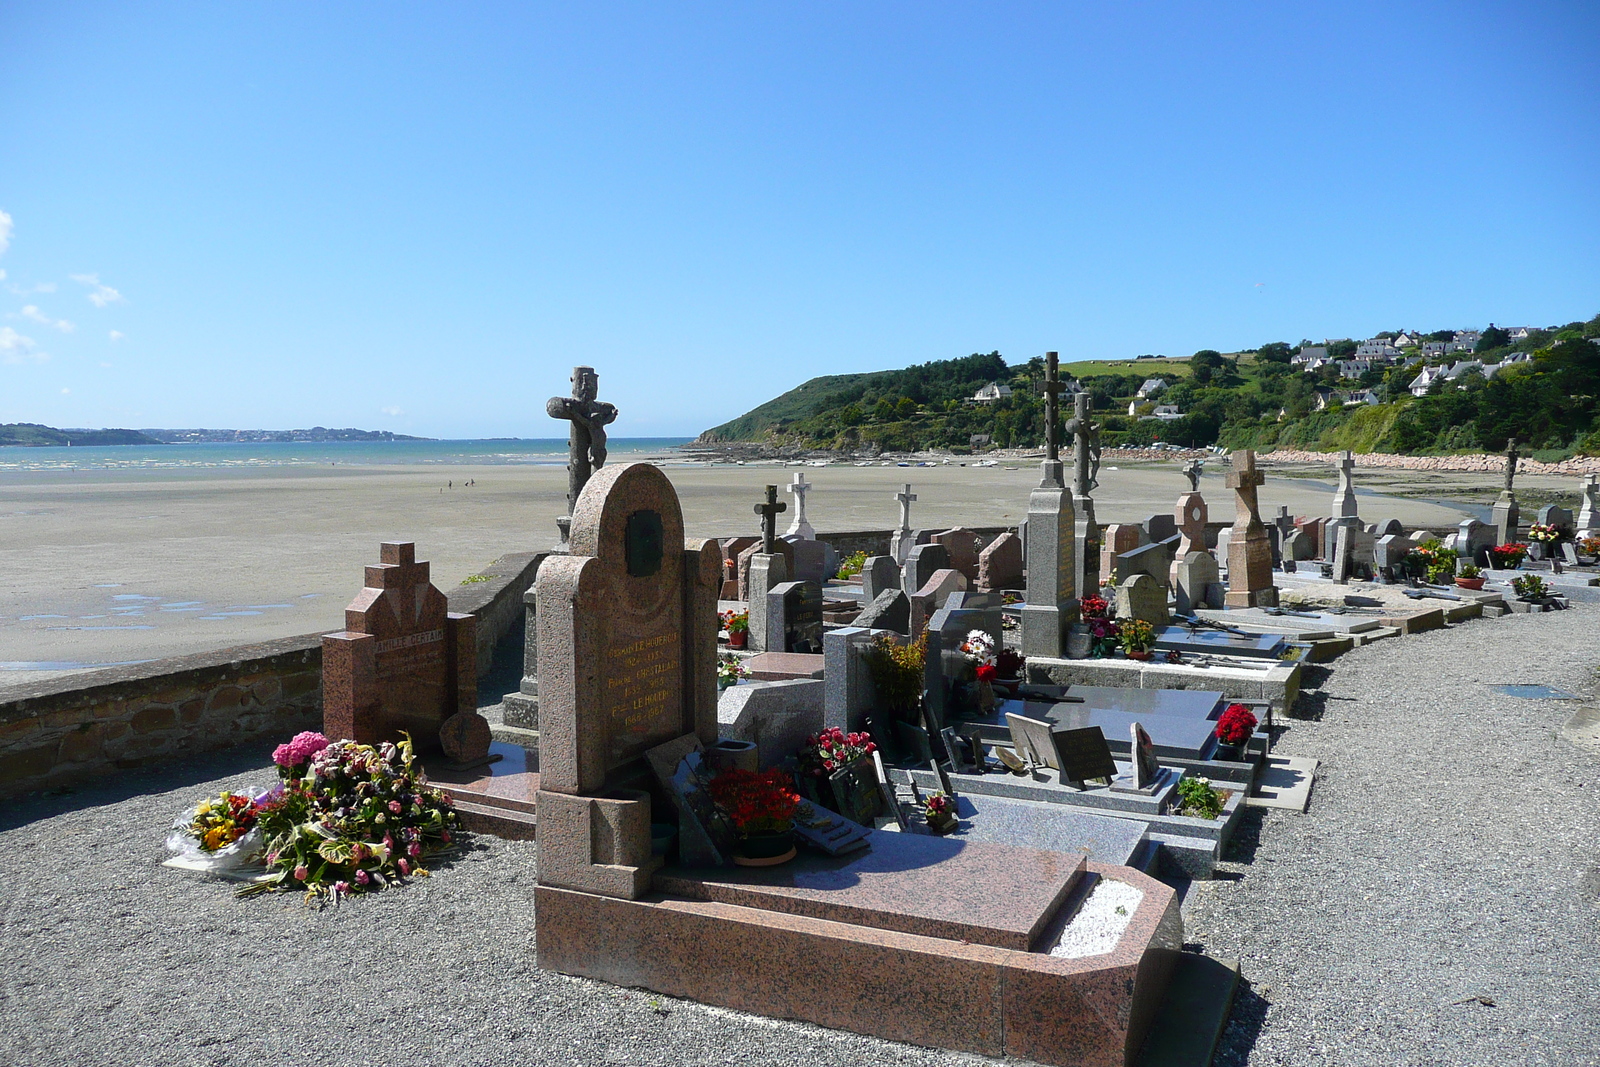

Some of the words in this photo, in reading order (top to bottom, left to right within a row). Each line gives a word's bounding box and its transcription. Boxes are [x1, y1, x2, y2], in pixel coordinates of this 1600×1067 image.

[377, 637, 407, 653] AMILLE
[410, 629, 443, 645] CERTAIN
[633, 697, 643, 710] LE
